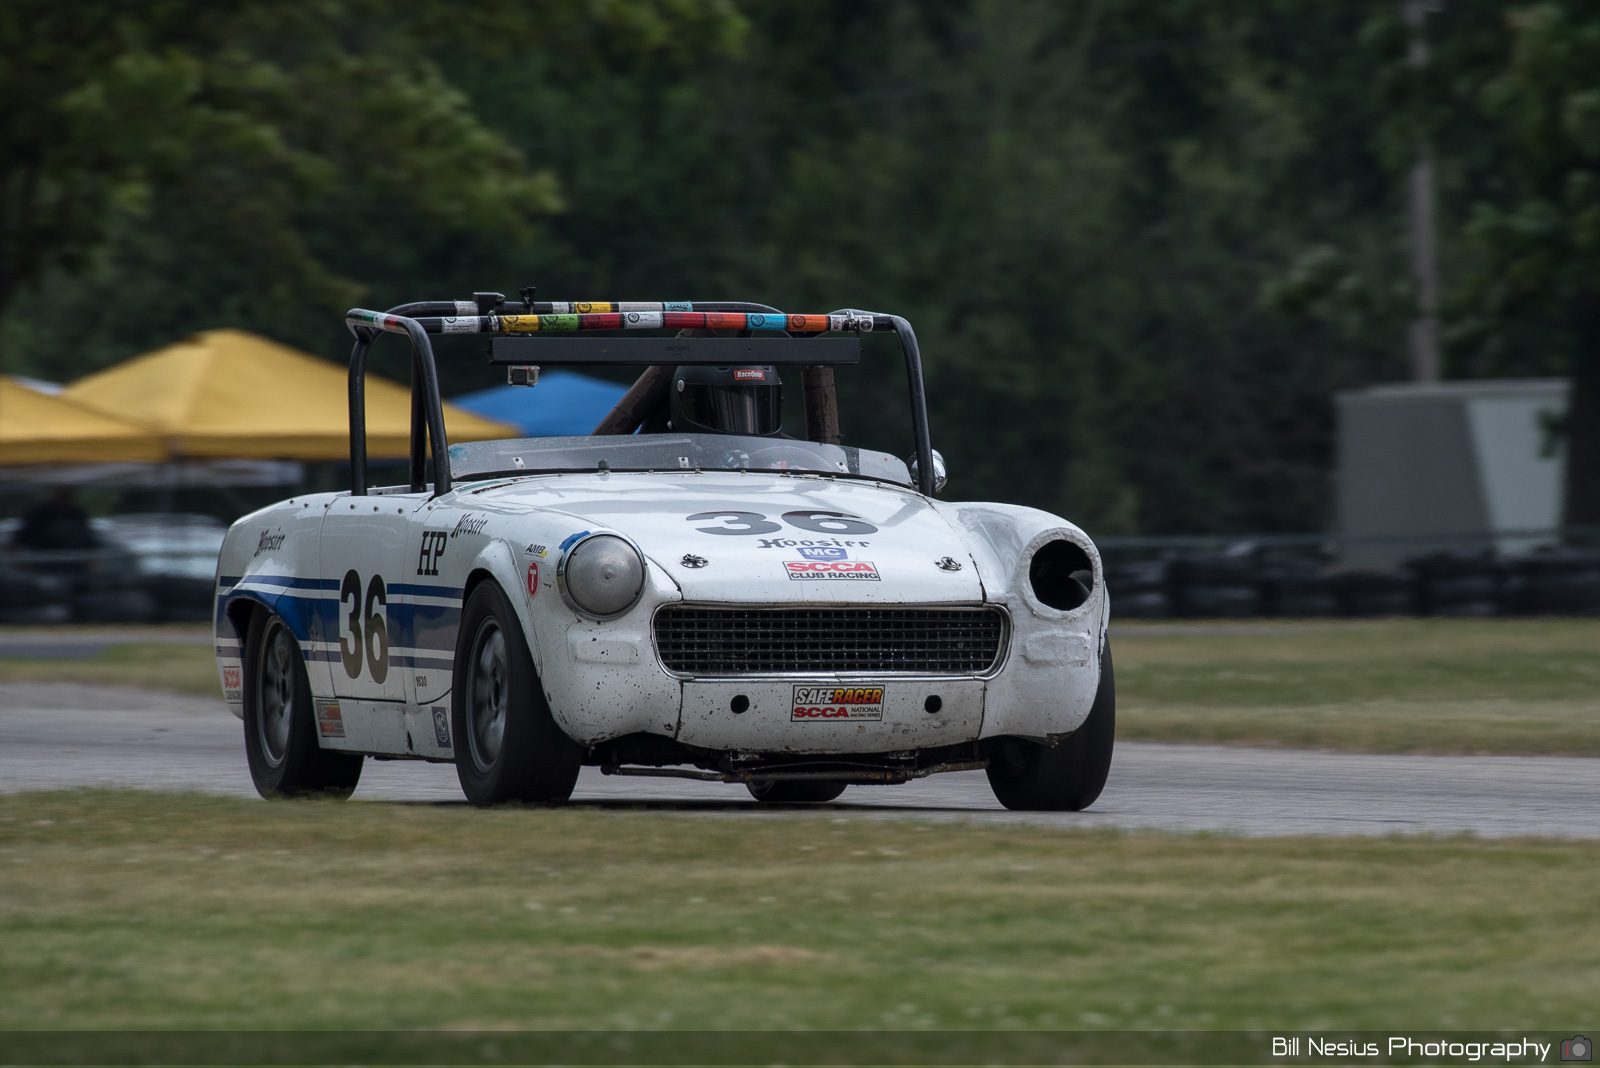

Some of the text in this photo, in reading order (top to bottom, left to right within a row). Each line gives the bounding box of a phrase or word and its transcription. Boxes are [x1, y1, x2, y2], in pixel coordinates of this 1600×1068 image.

[737, 371, 763, 380] RaceQuip
[686, 511, 879, 535] 36
[417, 531, 447, 576] HP
[786, 562, 875, 572] SCCA
[340, 568, 388, 684] 36
[793, 707, 849, 718] SCCA
